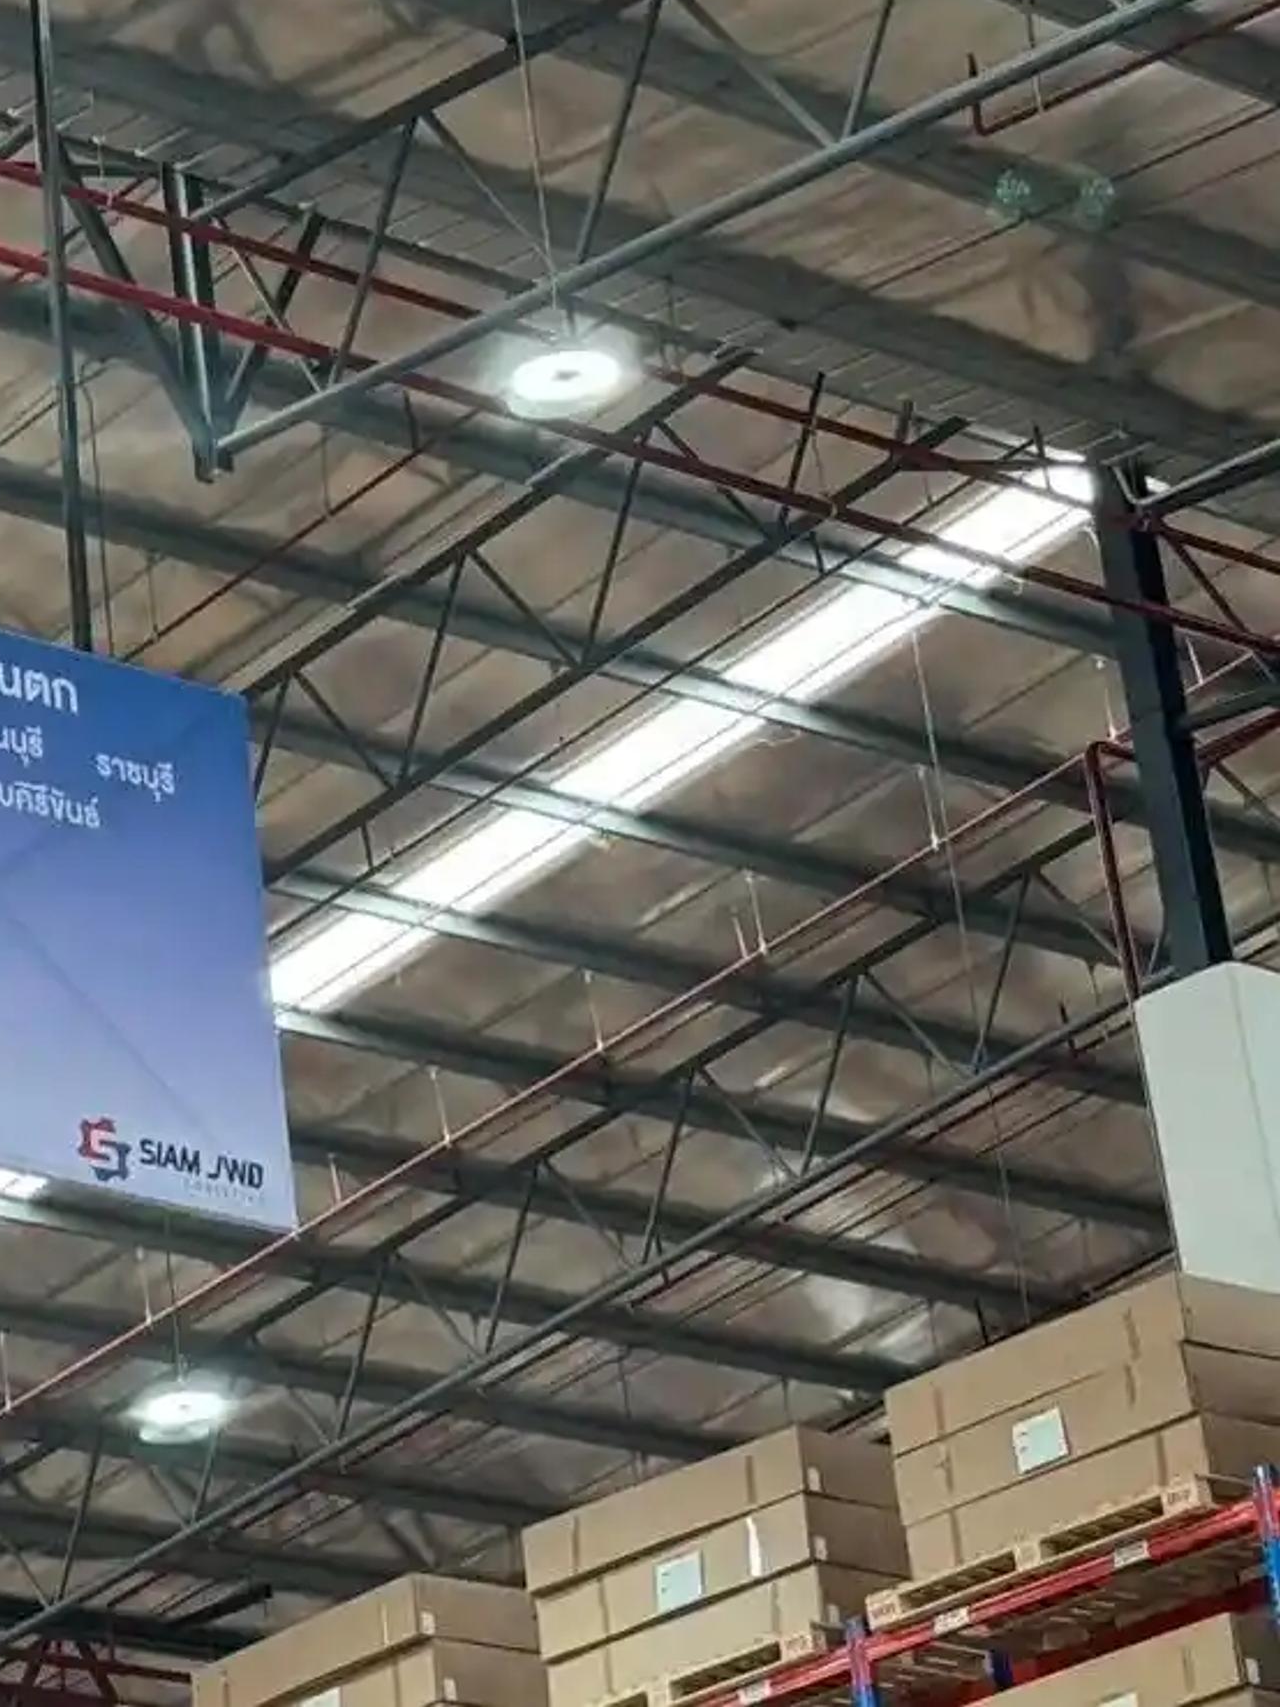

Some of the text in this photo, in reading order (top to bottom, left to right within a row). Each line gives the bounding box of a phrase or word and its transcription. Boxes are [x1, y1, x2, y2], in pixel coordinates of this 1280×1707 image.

[94, 752, 175, 802] ราชบุรี
[139, 1138, 264, 1189] SIAM JWD
